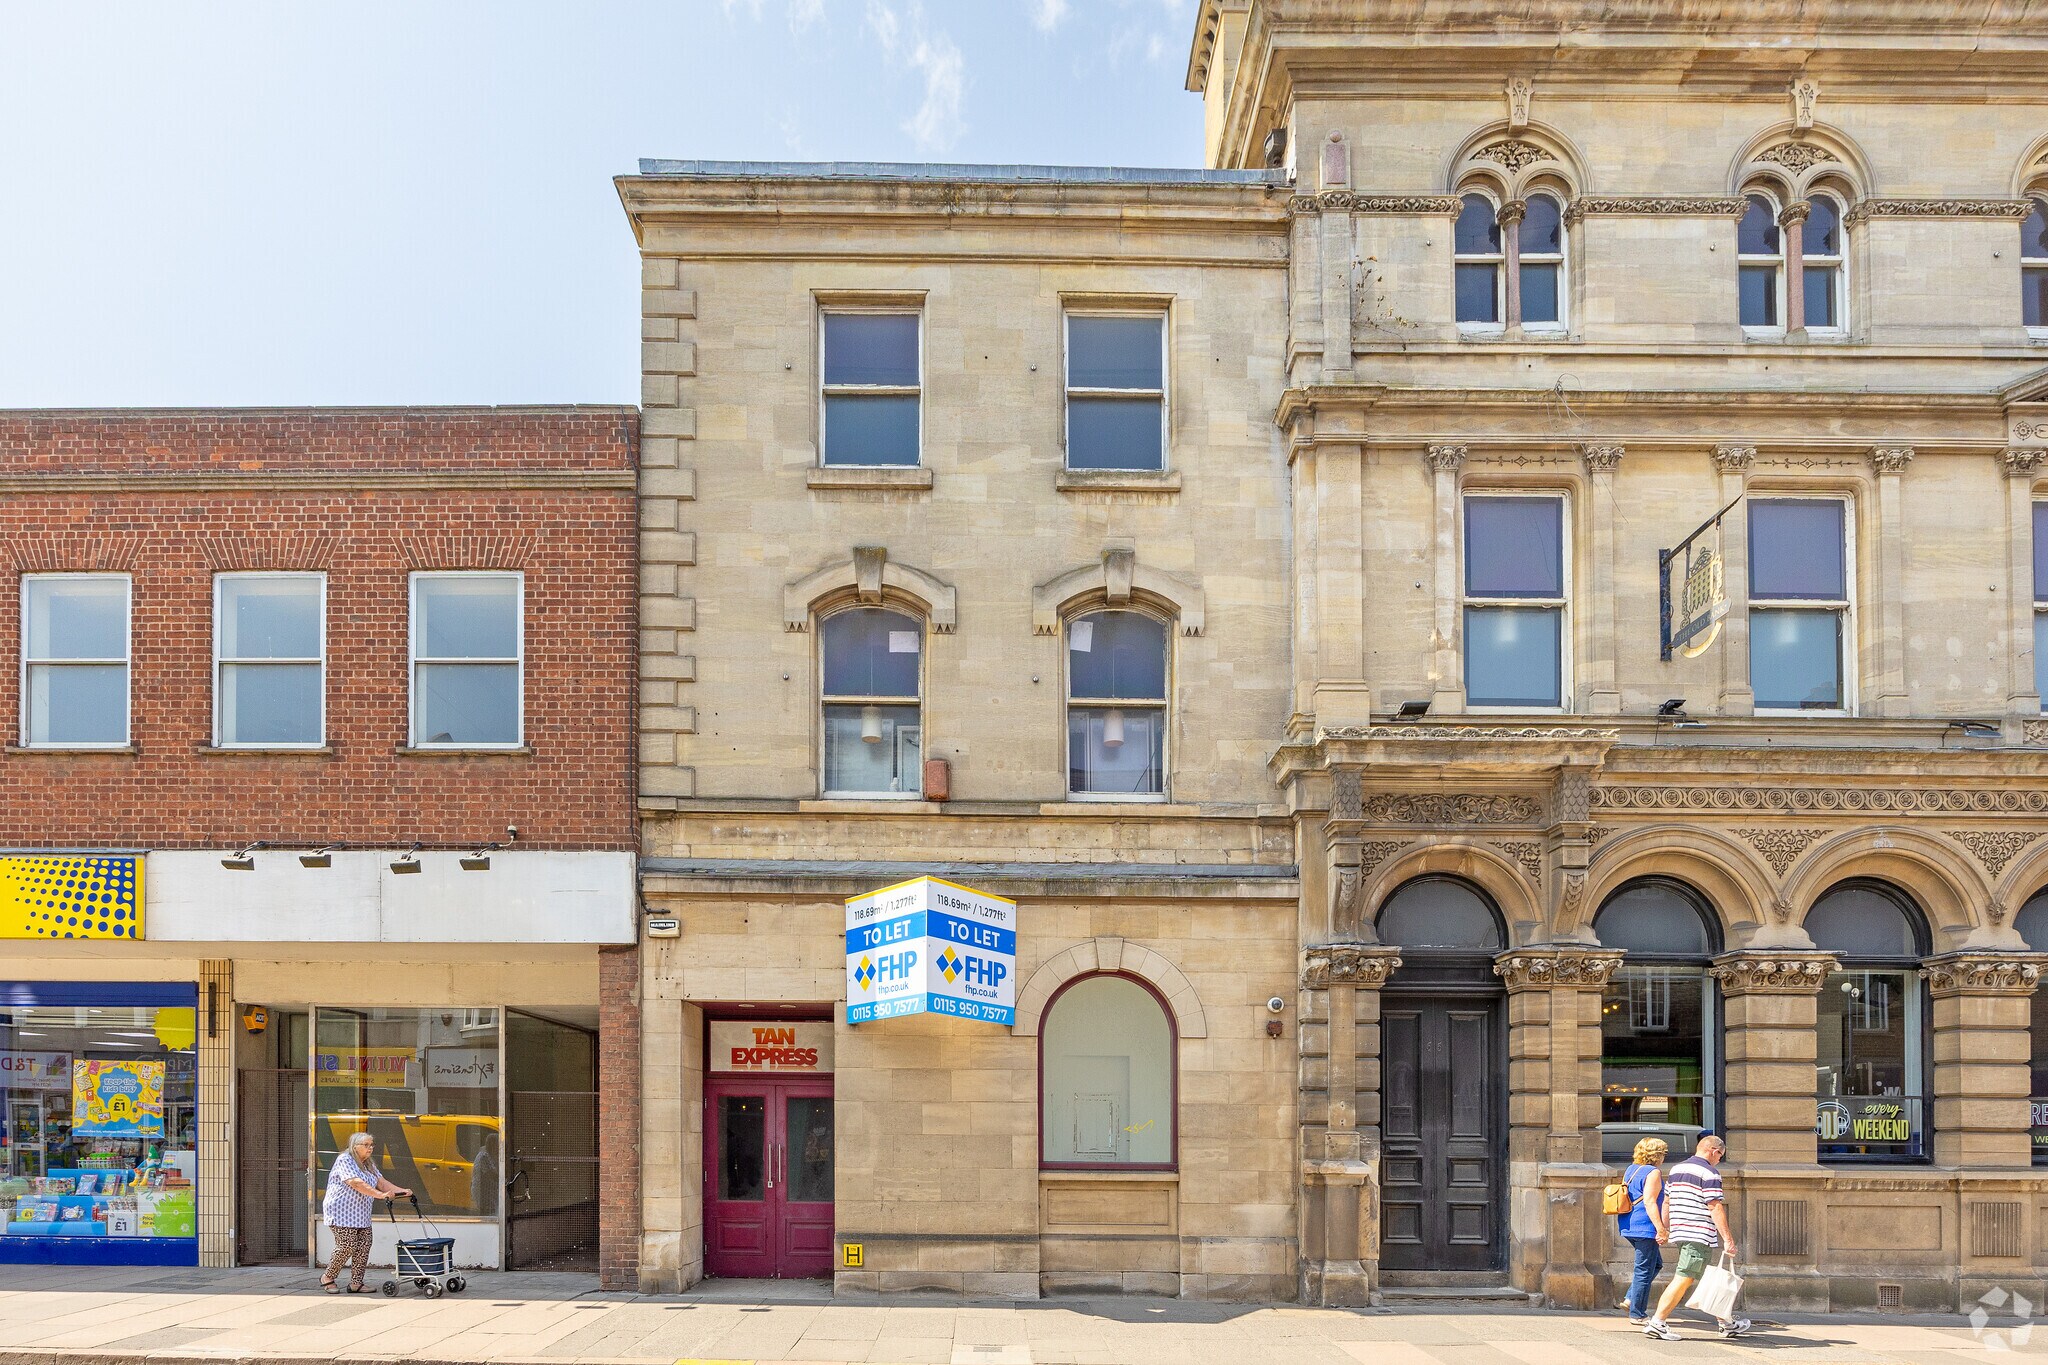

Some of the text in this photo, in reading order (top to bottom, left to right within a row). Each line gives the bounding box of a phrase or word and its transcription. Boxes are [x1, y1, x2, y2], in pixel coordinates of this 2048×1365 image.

[863, 919, 911, 946] TO LET
[948, 920, 1000, 948] TO LET
[878, 950, 917, 983] FHP
[965, 955, 1007, 987] FHP
[878, 981, 909, 995] fhp.co.uk
[965, 984, 998, 998] fhp.co.uk
[853, 998, 919, 1020] 0115 950 7577
[933, 997, 1008, 1021] 0115 950 7577
[752, 1027, 795, 1045] TAN
[731, 1048, 818, 1066] EXPRESS
[114, 1102, 125, 1111] £1
[1822, 1111, 1839, 1139] DJ
[1853, 1119, 1909, 1140] WEEKEND
[115, 1222, 127, 1231] £1
[846, 1246, 859, 1264] H
